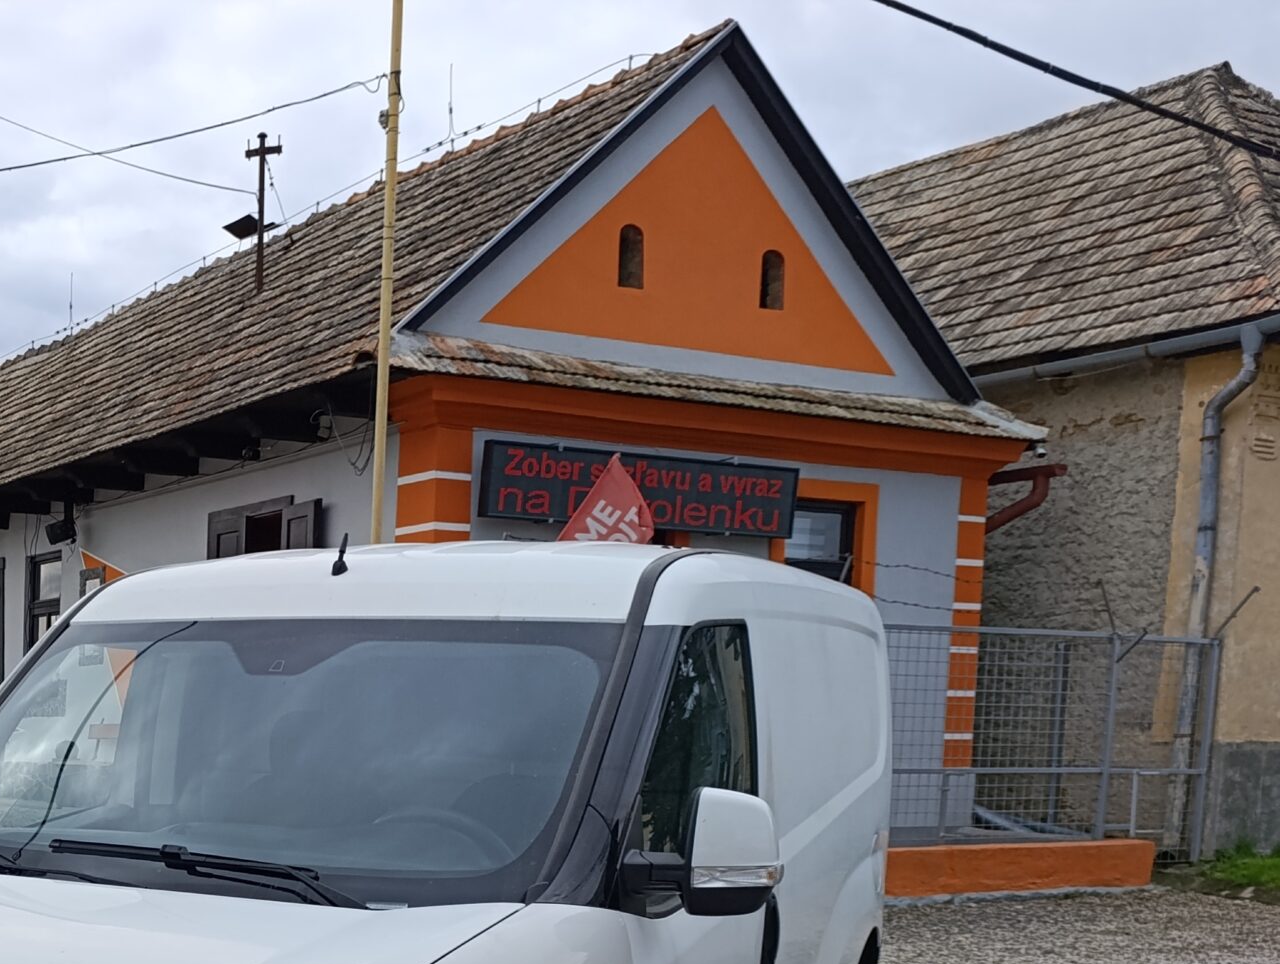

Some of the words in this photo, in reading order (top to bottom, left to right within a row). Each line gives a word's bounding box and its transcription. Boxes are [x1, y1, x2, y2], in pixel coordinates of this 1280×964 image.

[504, 448, 584, 480] Zober
[698, 473, 712, 493] a
[498, 487, 551, 515] na
[568, 486, 780, 532] olenku
